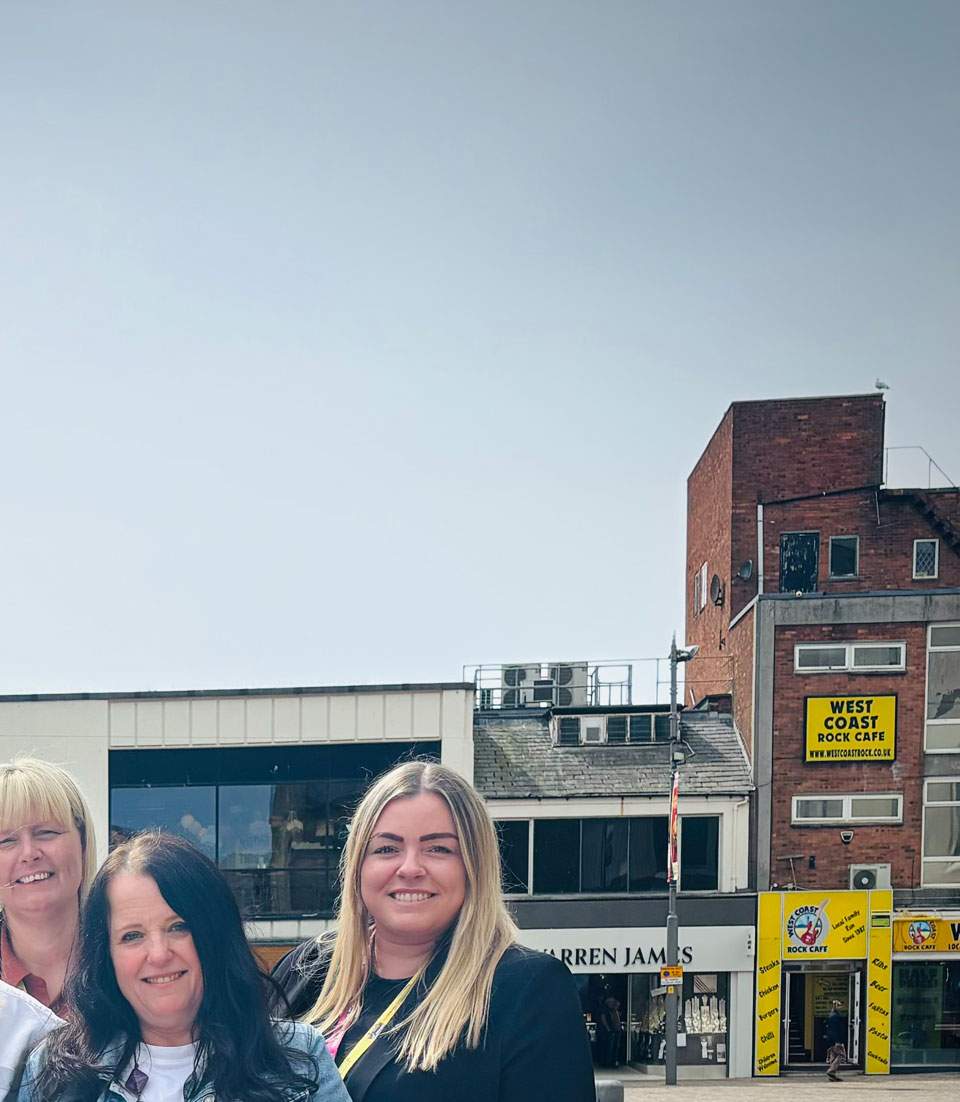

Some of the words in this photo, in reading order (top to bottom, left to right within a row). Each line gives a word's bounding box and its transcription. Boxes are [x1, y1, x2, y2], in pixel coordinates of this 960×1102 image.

[830, 700, 873, 714] WEST
[824, 716, 878, 730] COAST
[818, 732, 850, 743] ROCK
[855, 731, 885, 742] CAFE
[809, 749, 891, 758] WWW.WESTCOASTROCK.CO.UK
[787, 915, 795, 938] WEST
[794, 906, 819, 916] COAST
[543, 947, 617, 966] RREN
[624, 946, 693, 967] JAMS
[759, 960, 780, 974] Steaks
[871, 958, 888, 970] Ribs
[758, 984, 779, 998] Chicken
[869, 980, 888, 992] Beer
[758, 1007, 779, 1021] Burgers
[868, 1027, 888, 1040] Pasta
